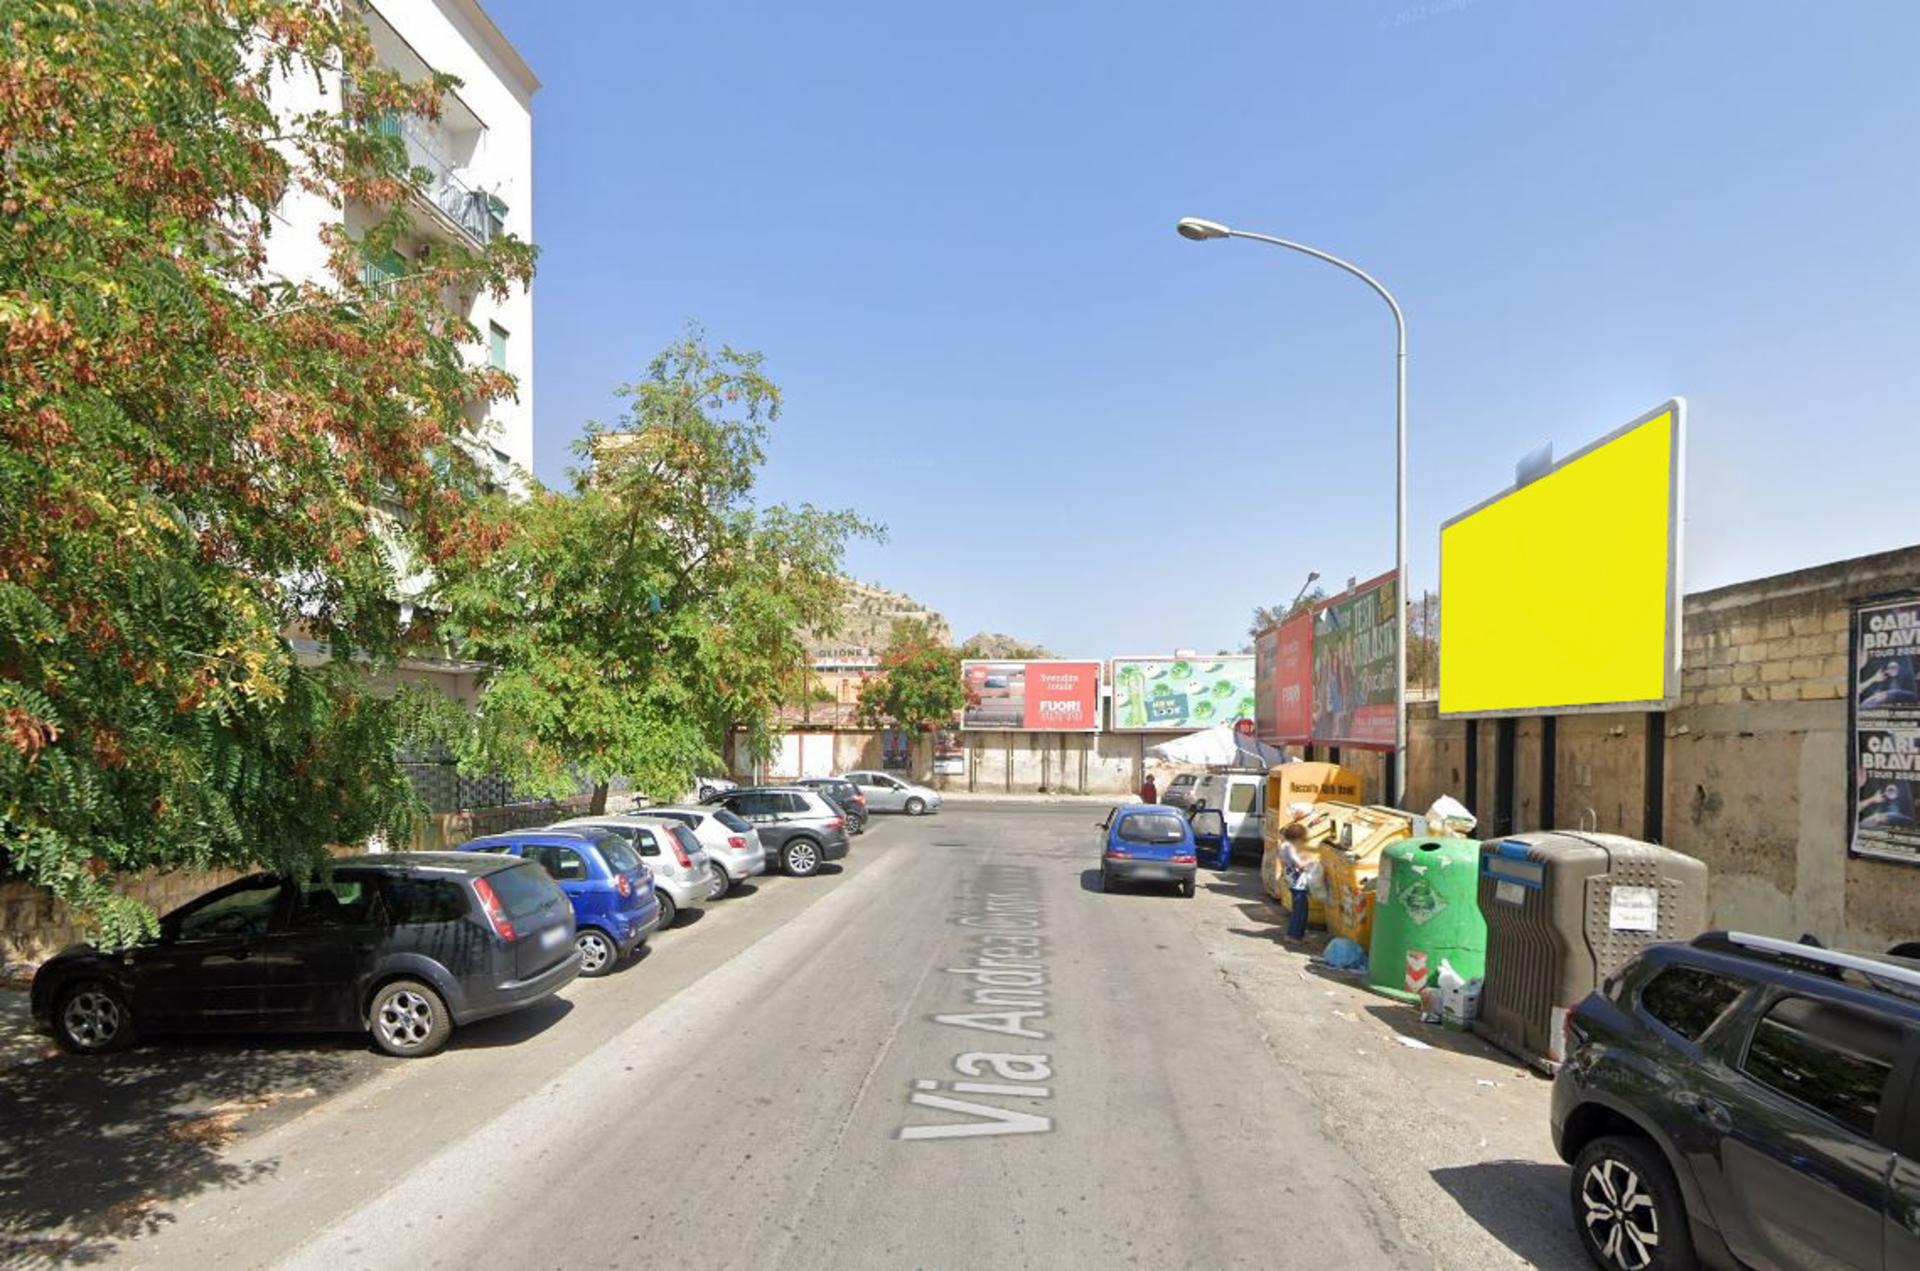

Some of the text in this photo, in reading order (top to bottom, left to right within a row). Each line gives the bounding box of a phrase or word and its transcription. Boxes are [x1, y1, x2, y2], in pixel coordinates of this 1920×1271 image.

[1869, 611, 1920, 632] CARL
[1040, 700, 1080, 712] FUORI
[1867, 735, 1919, 755] CARL
